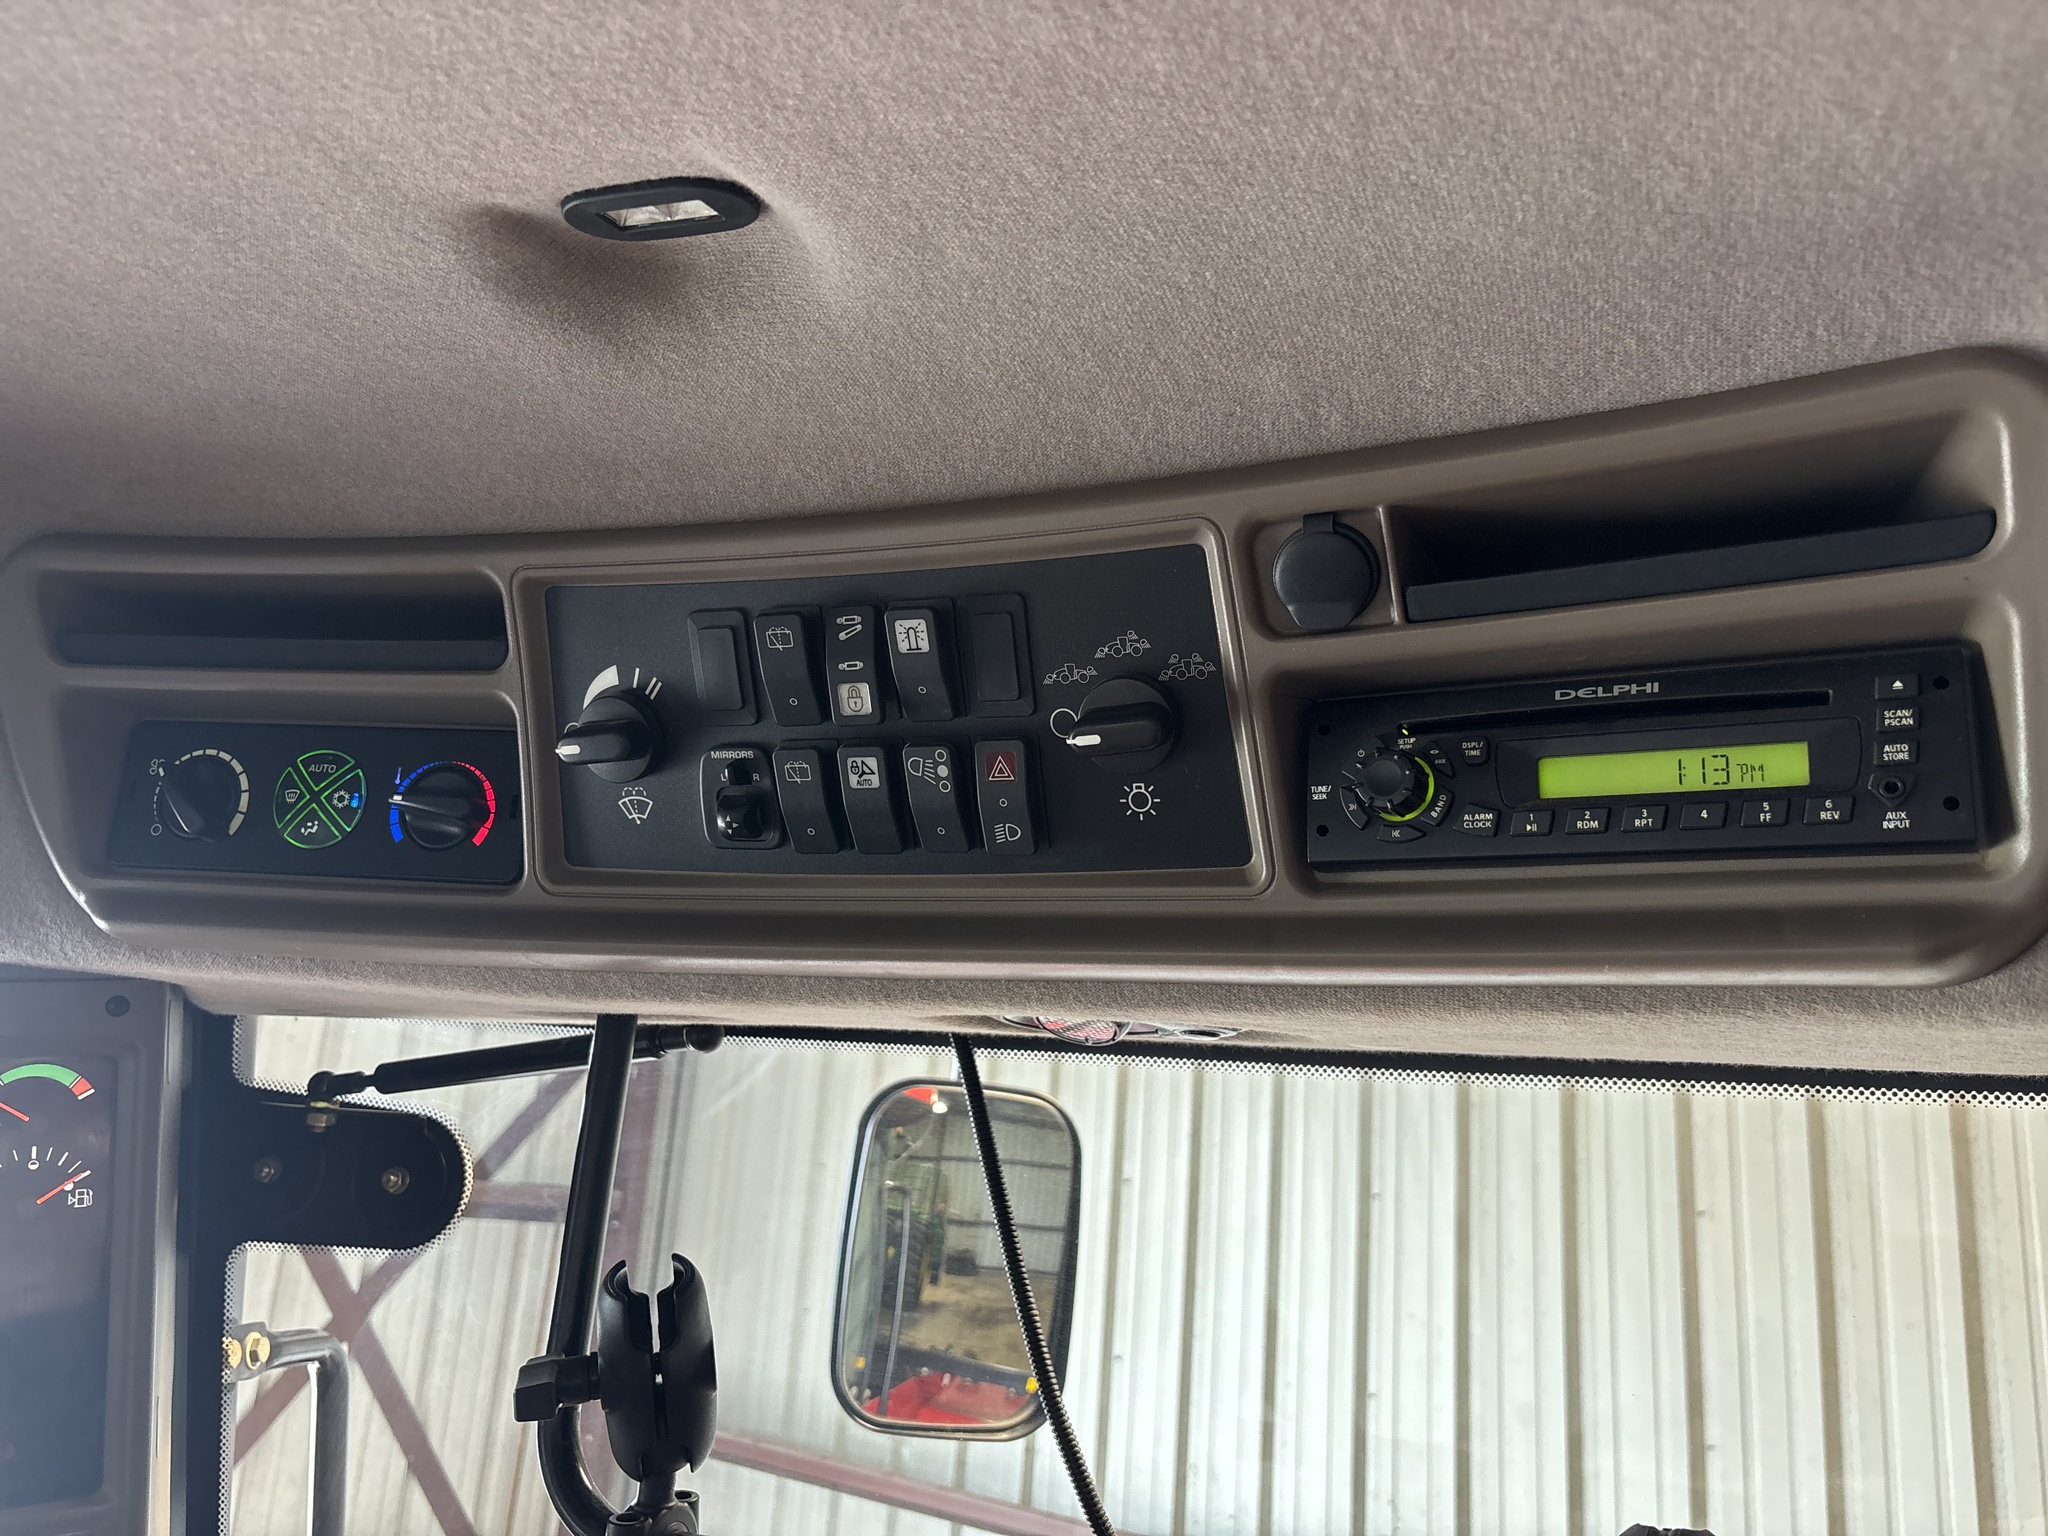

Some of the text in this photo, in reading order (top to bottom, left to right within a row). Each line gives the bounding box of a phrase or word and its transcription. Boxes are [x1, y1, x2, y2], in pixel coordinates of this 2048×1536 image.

[1554, 682, 1660, 701] DELPHI
[1883, 709, 1913, 719] SCAN/
[1884, 718, 1914, 727] PSCAN
[1462, 741, 1483, 749] DSPL/
[1883, 744, 1909, 753] AUTO
[711, 750, 754, 760] MIRRORS
[1464, 749, 1481, 757] TIME
[1883, 752, 1910, 761] STORE
[308, 763, 337, 774] AUTO
[1678, 754, 1765, 786] 1:13 PM
[752, 773, 760, 782] R
[856, 778, 873, 787] AUTO
[1310, 785, 1332, 794] TUNE/
[1430, 794, 1447, 818] BAND
[1762, 802, 1769, 811] 5
[1825, 800, 1832, 809] 6
[1463, 813, 1493, 821] ALARM
[1529, 813, 1534, 821] 1
[1584, 811, 1591, 819] 2
[1641, 809, 1648, 817] 3
[1700, 809, 1708, 819] 4
[1759, 813, 1772, 822] FF
[1819, 811, 1840, 820] REV
[1885, 811, 1907, 821] AUX
[1463, 821, 1492, 829] CLOCK
[1576, 820, 1599, 829] RDM
[1634, 818, 1653, 827] RPT
[1882, 820, 1911, 829] INPUT
